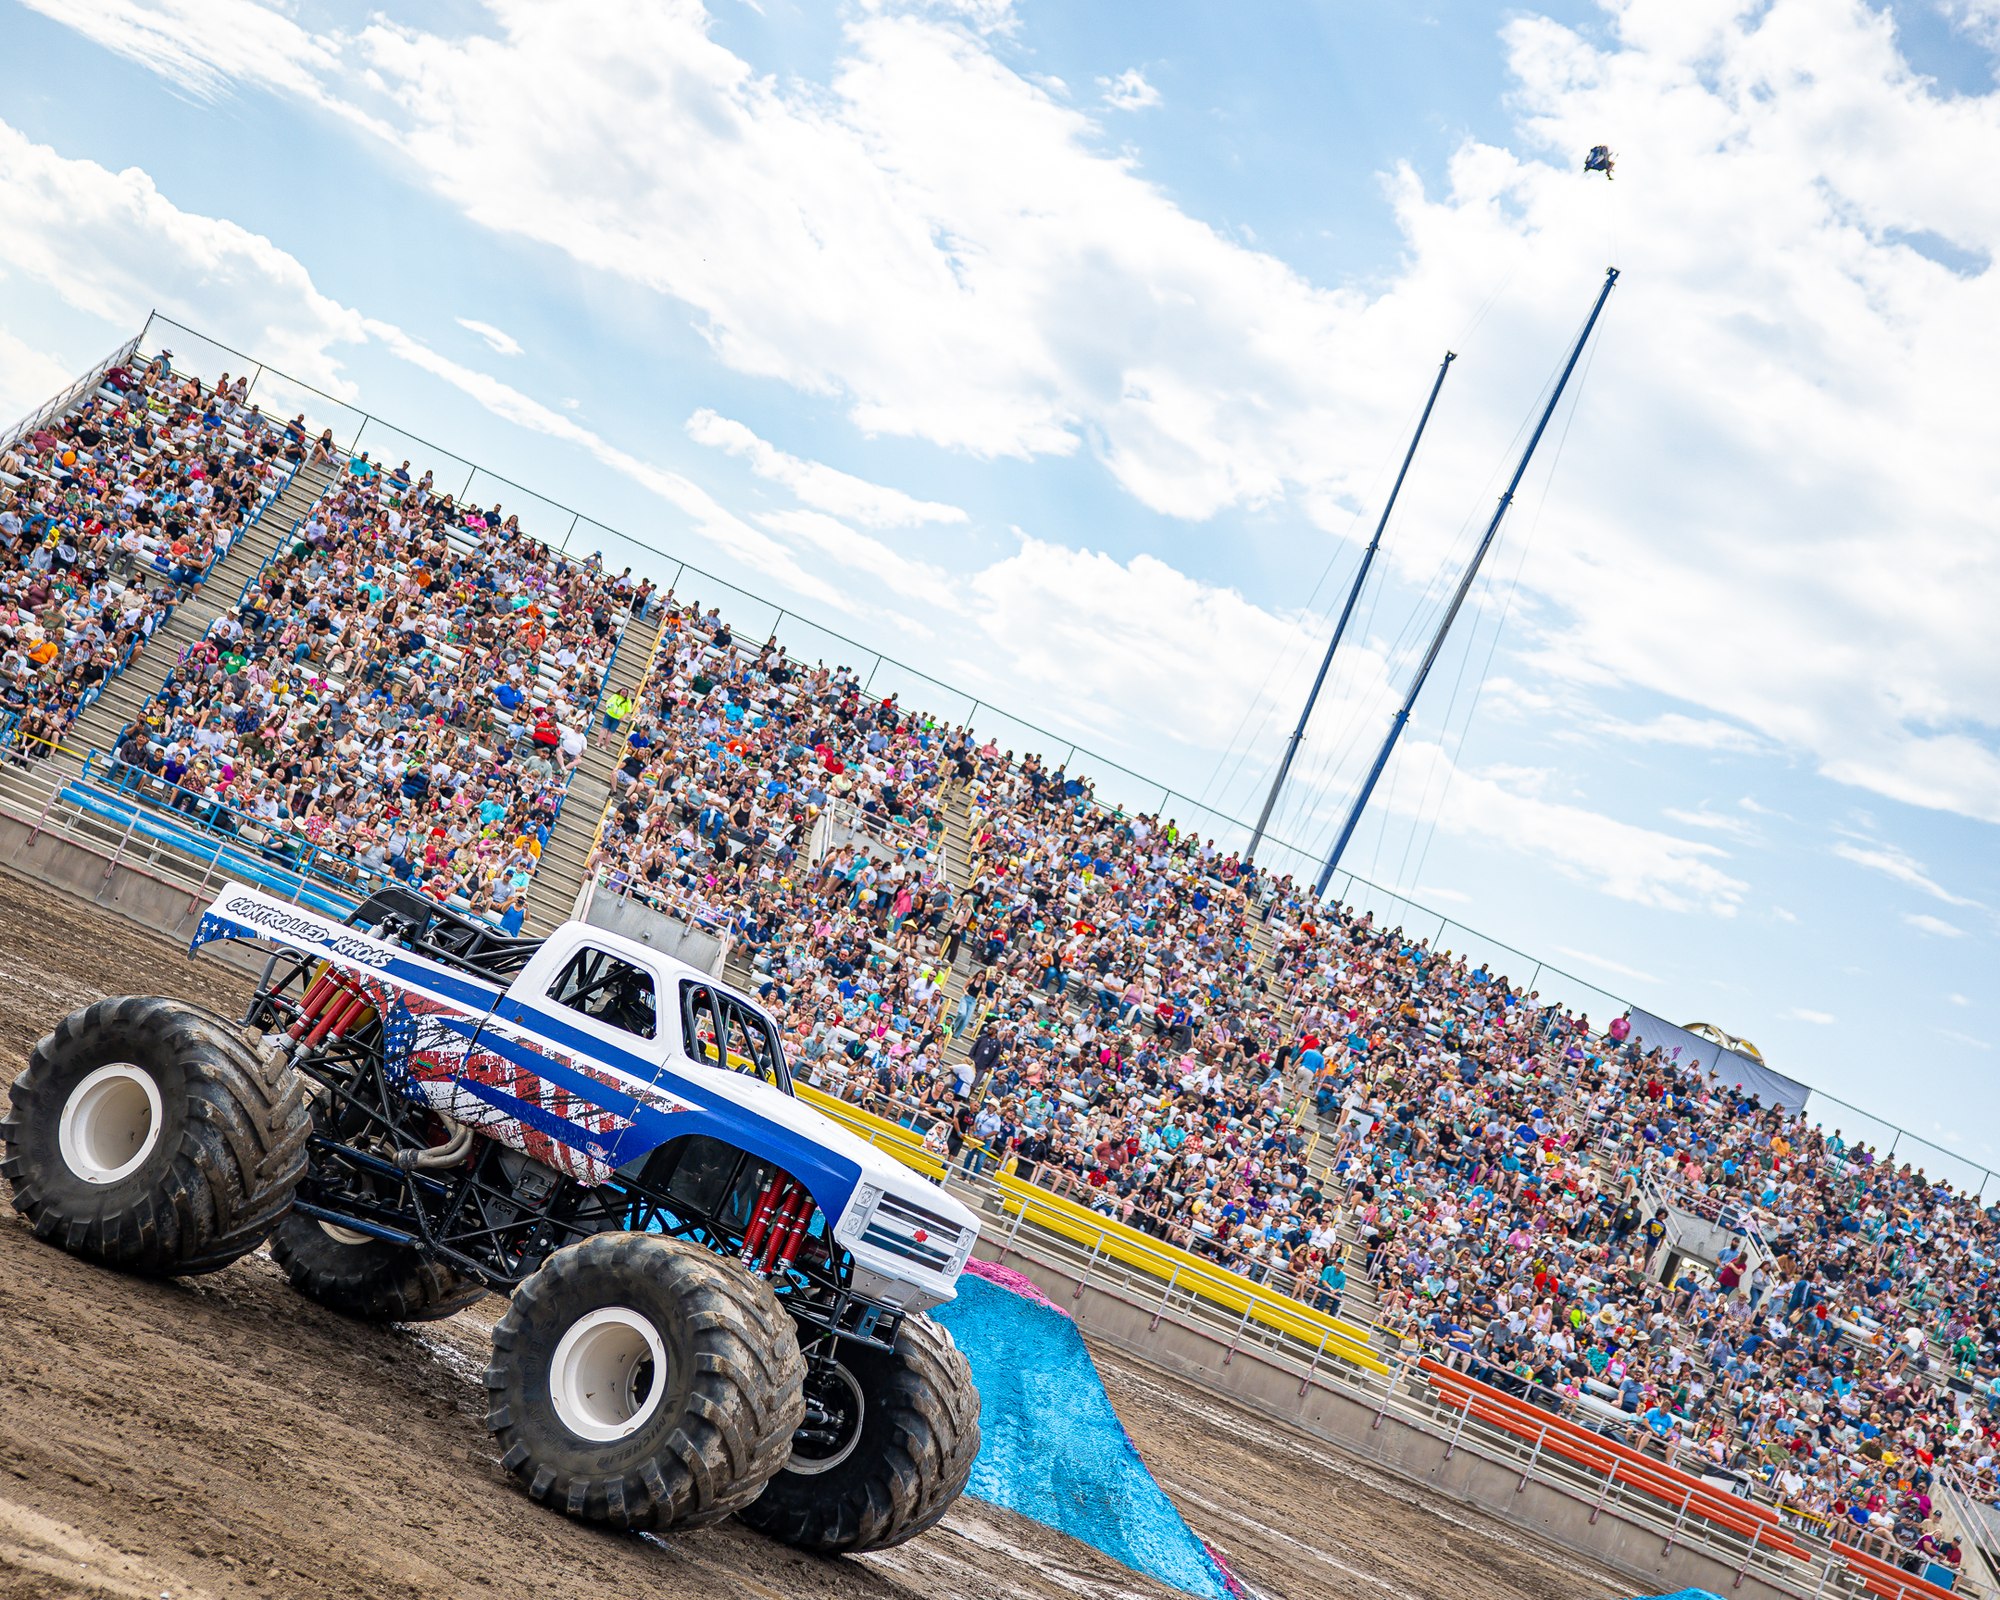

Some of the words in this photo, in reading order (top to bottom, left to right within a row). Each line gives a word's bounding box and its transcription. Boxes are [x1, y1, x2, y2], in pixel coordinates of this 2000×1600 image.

[226, 898, 329, 943] CONTROLLED
[331, 936, 395, 968] KHOAS
[492, 1200, 514, 1215] KCM
[597, 1416, 667, 1466] MICHELIN
